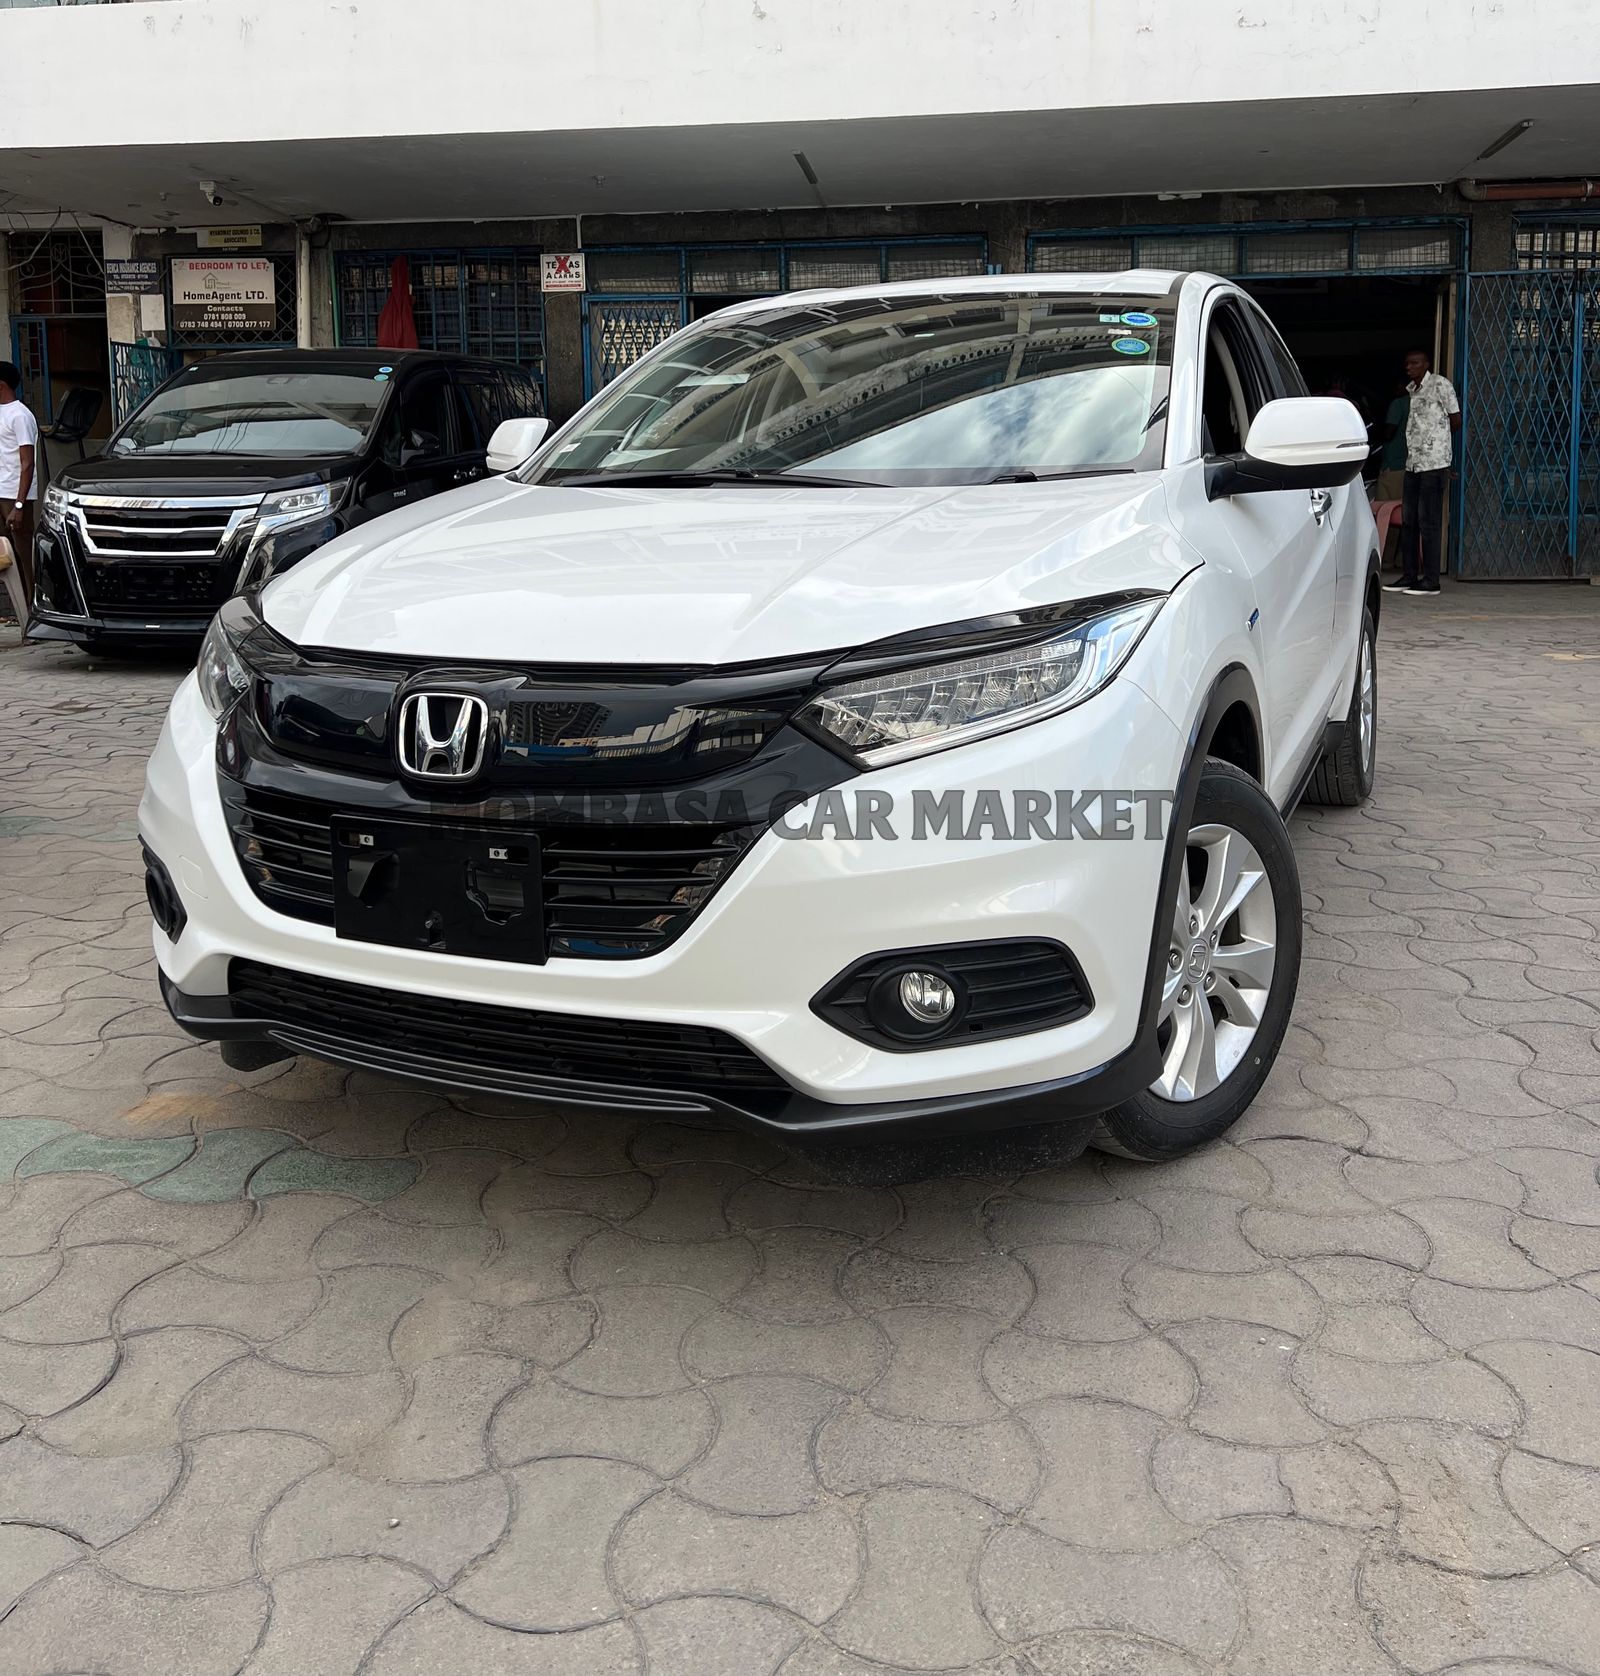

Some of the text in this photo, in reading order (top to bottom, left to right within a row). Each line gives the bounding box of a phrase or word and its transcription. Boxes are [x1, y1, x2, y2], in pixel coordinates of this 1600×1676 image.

[189, 262, 233, 270] BEDROOM
[237, 262, 248, 270] TO
[546, 256, 580, 274] TEXAS
[183, 291, 268, 302] HomeAgent LTD.
